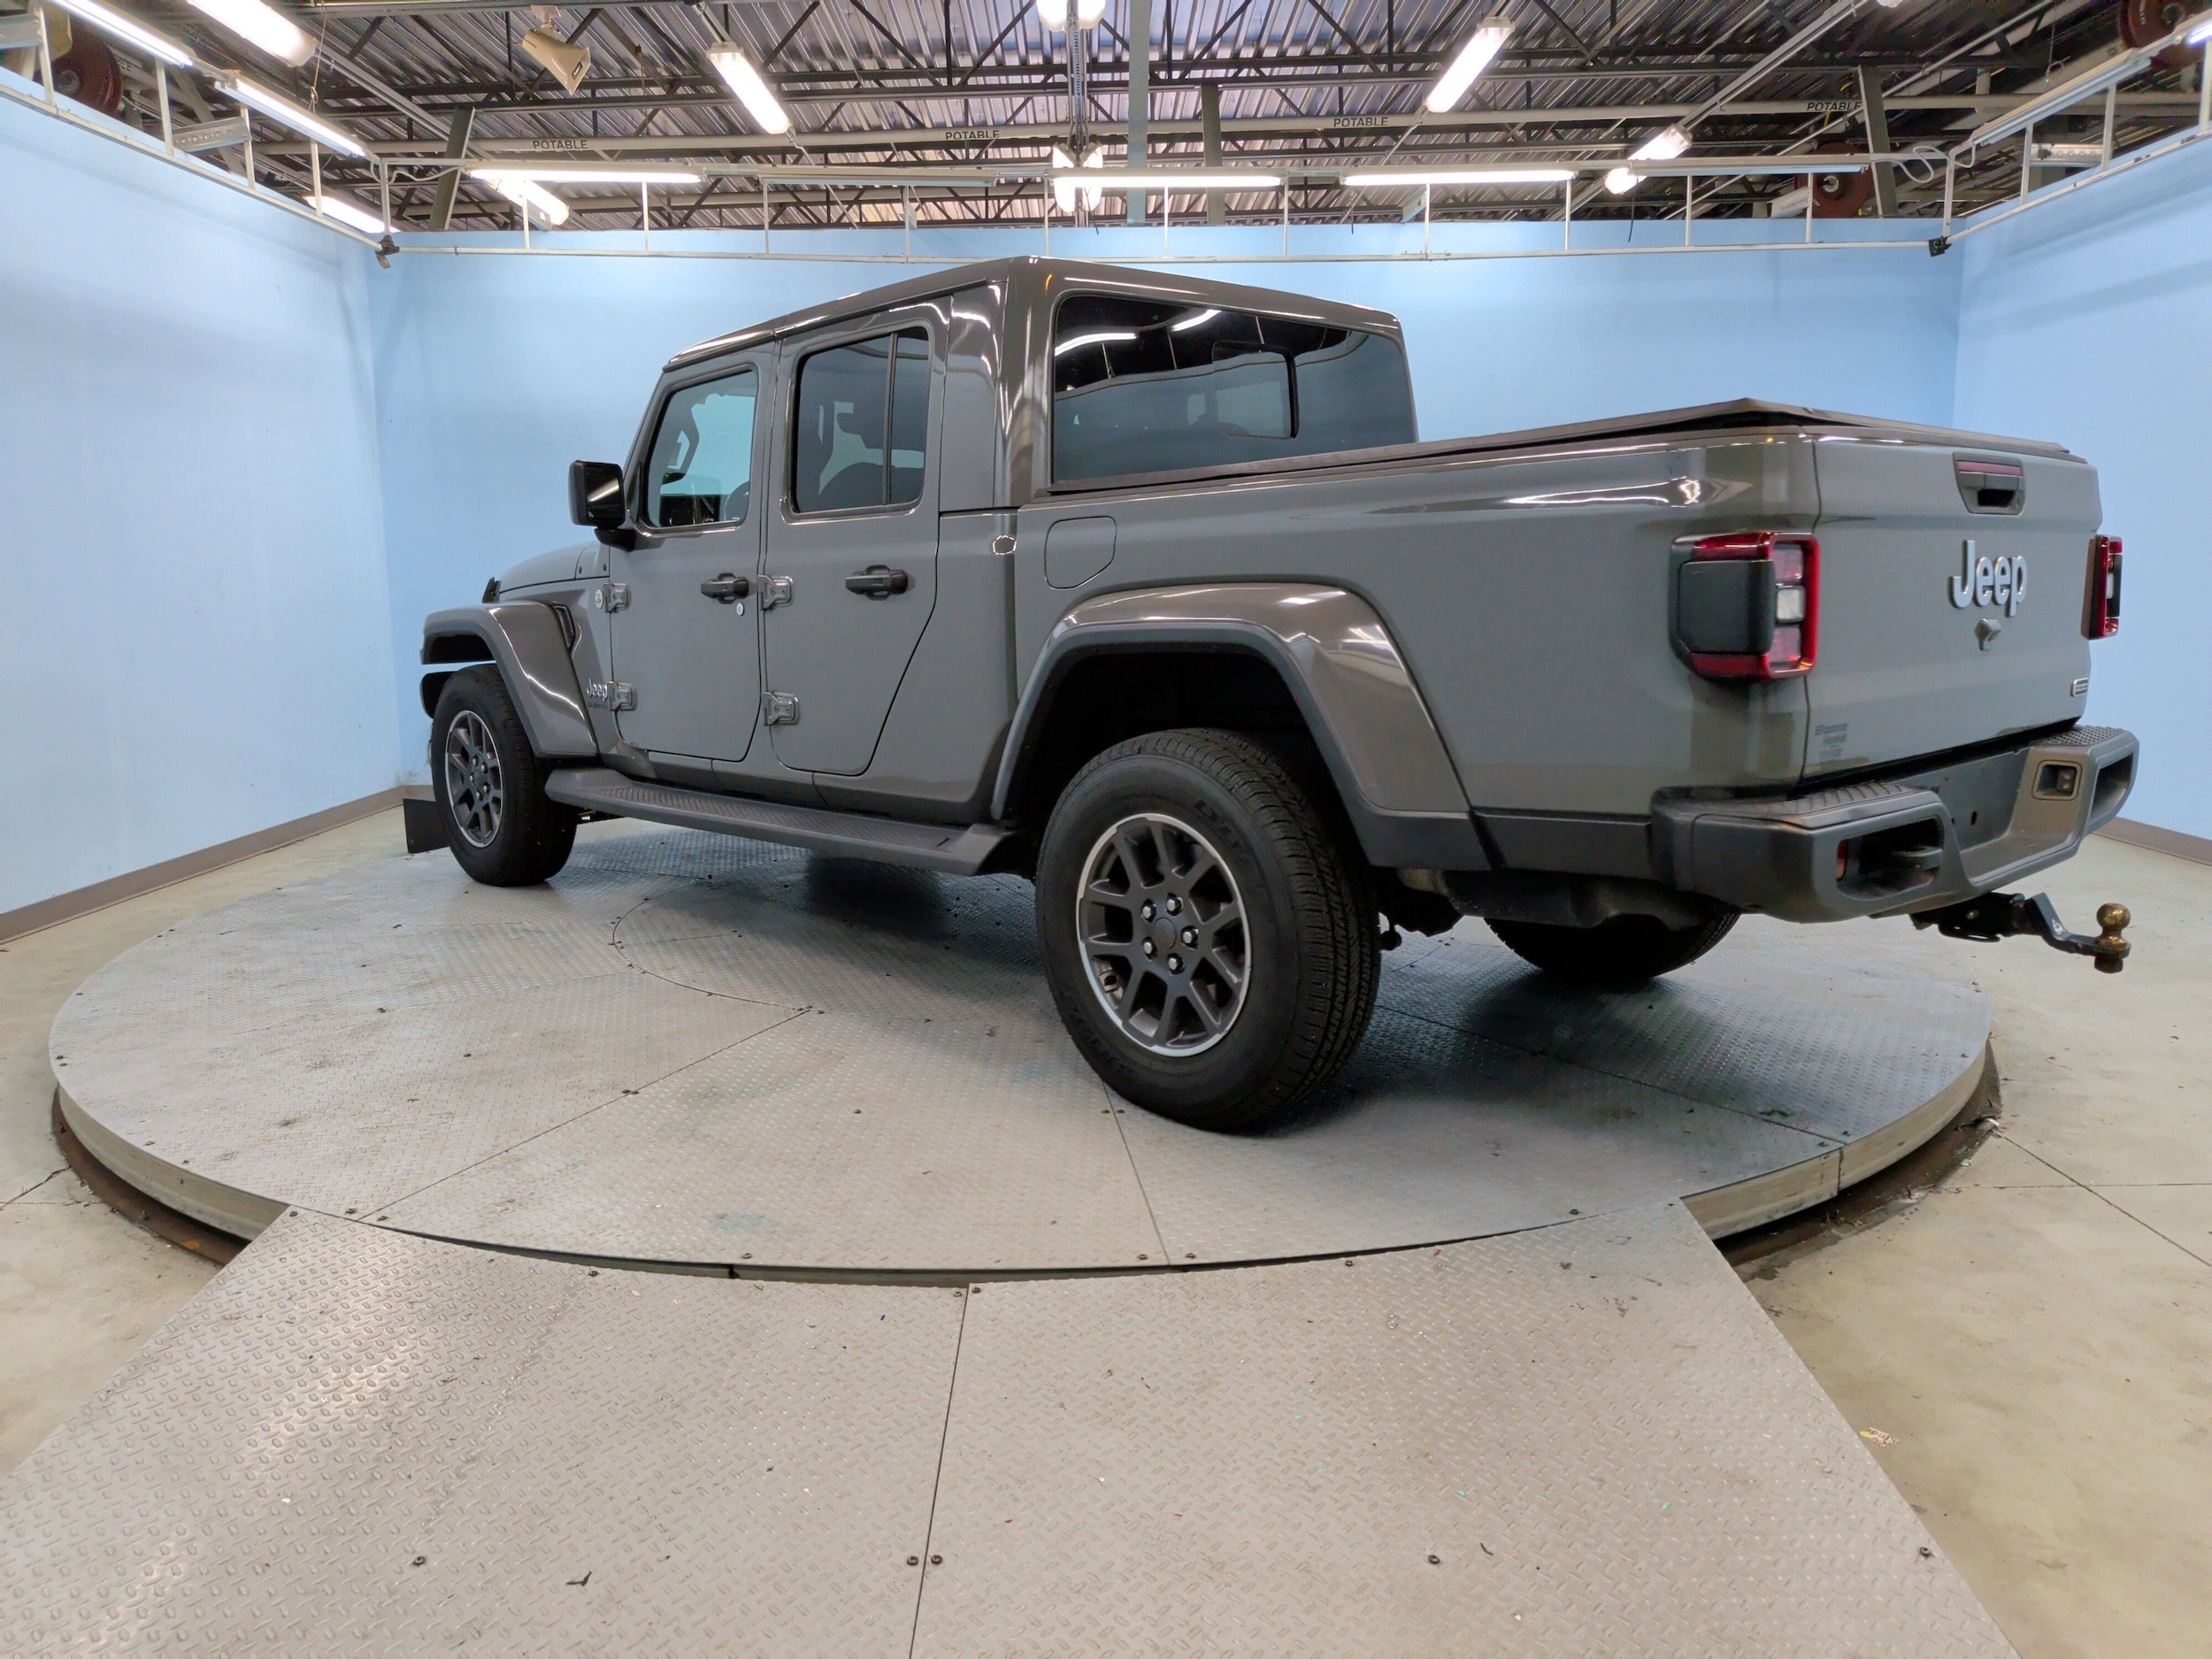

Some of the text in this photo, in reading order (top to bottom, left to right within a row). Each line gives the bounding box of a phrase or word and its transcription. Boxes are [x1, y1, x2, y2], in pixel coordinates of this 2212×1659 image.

[1333, 117, 1388, 127] POTABLE
[945, 129, 1000, 140] POTABLE
[533, 140, 588, 150] POTABLE
[1947, 539, 2028, 618] Jeep
[587, 678, 608, 703] Jeep
